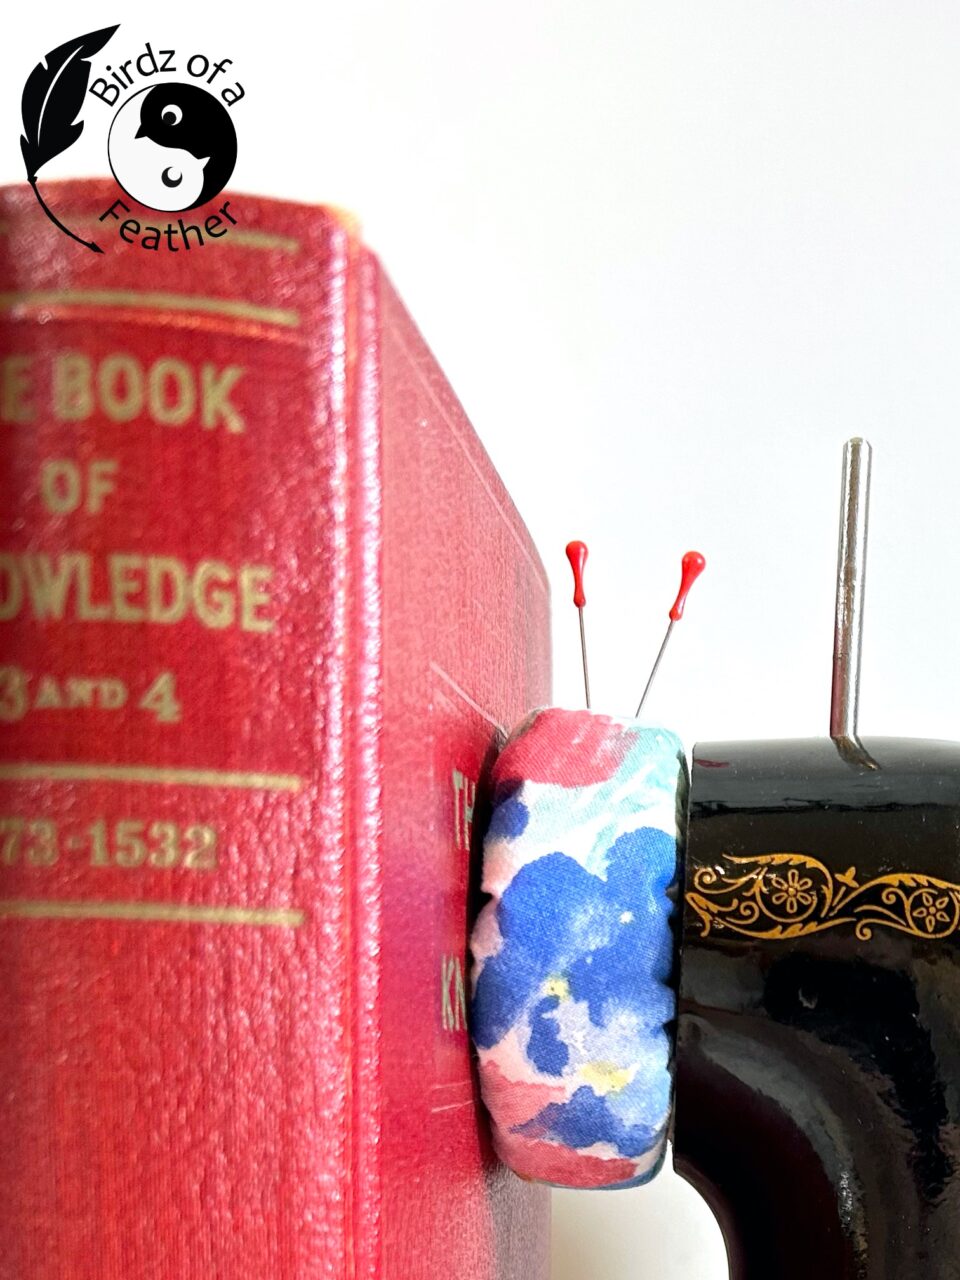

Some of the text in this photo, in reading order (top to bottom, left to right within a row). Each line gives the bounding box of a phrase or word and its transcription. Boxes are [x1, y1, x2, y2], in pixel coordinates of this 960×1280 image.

[54, 354, 244, 433] BOOK
[40, 459, 117, 513] OF
[0, 552, 276, 633] OWLEDGE
[0, 664, 182, 723] 3 AND 4
[452, 768, 476, 850] TH
[0, 817, 219, 871] 73-1532
